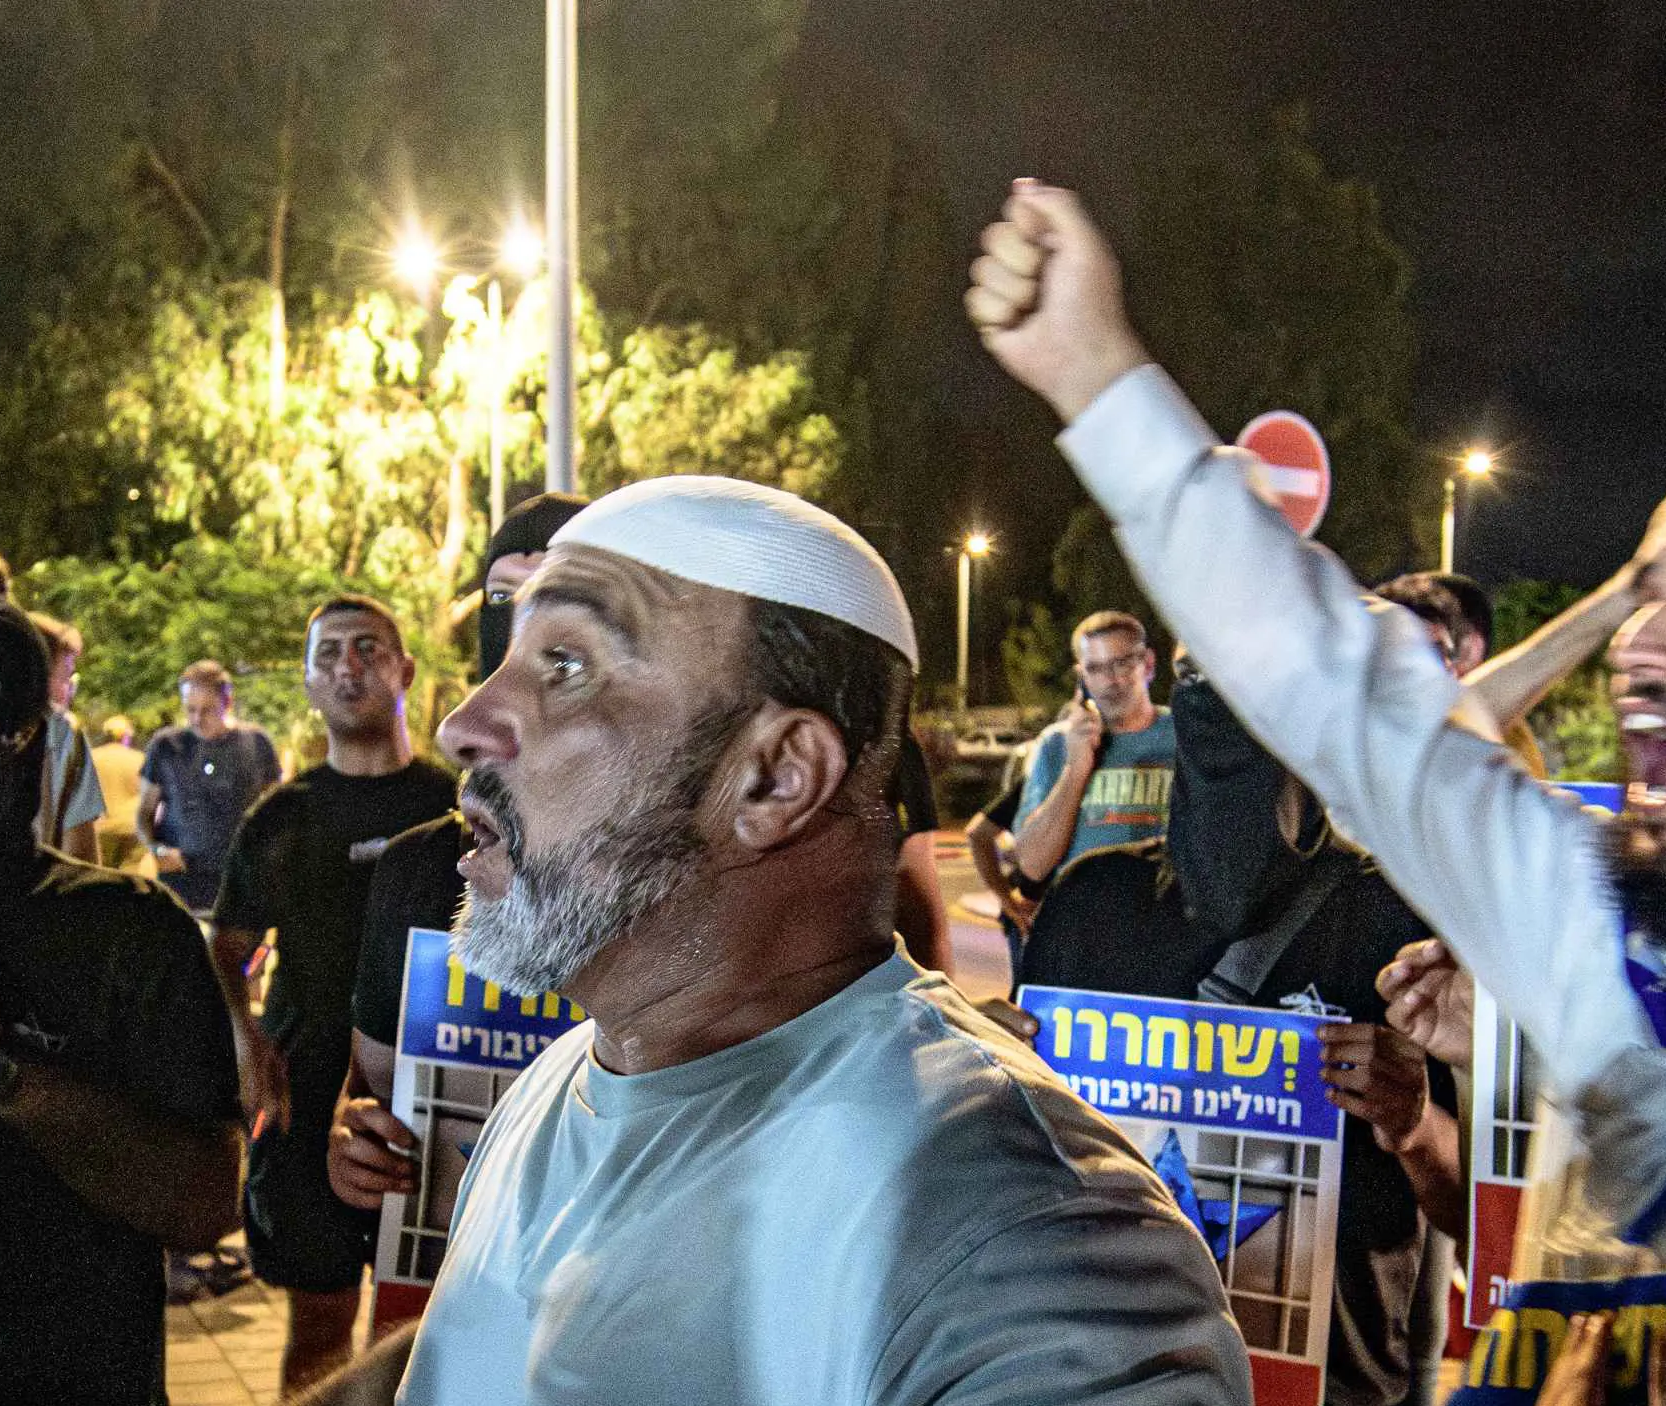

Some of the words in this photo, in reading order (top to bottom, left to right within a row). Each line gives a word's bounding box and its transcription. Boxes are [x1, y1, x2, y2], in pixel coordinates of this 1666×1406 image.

[435, 1022, 557, 1062] יבורים
[1058, 1074, 1182, 1114] הגיבורי
[1193, 1085, 1302, 1127] חיילינו
